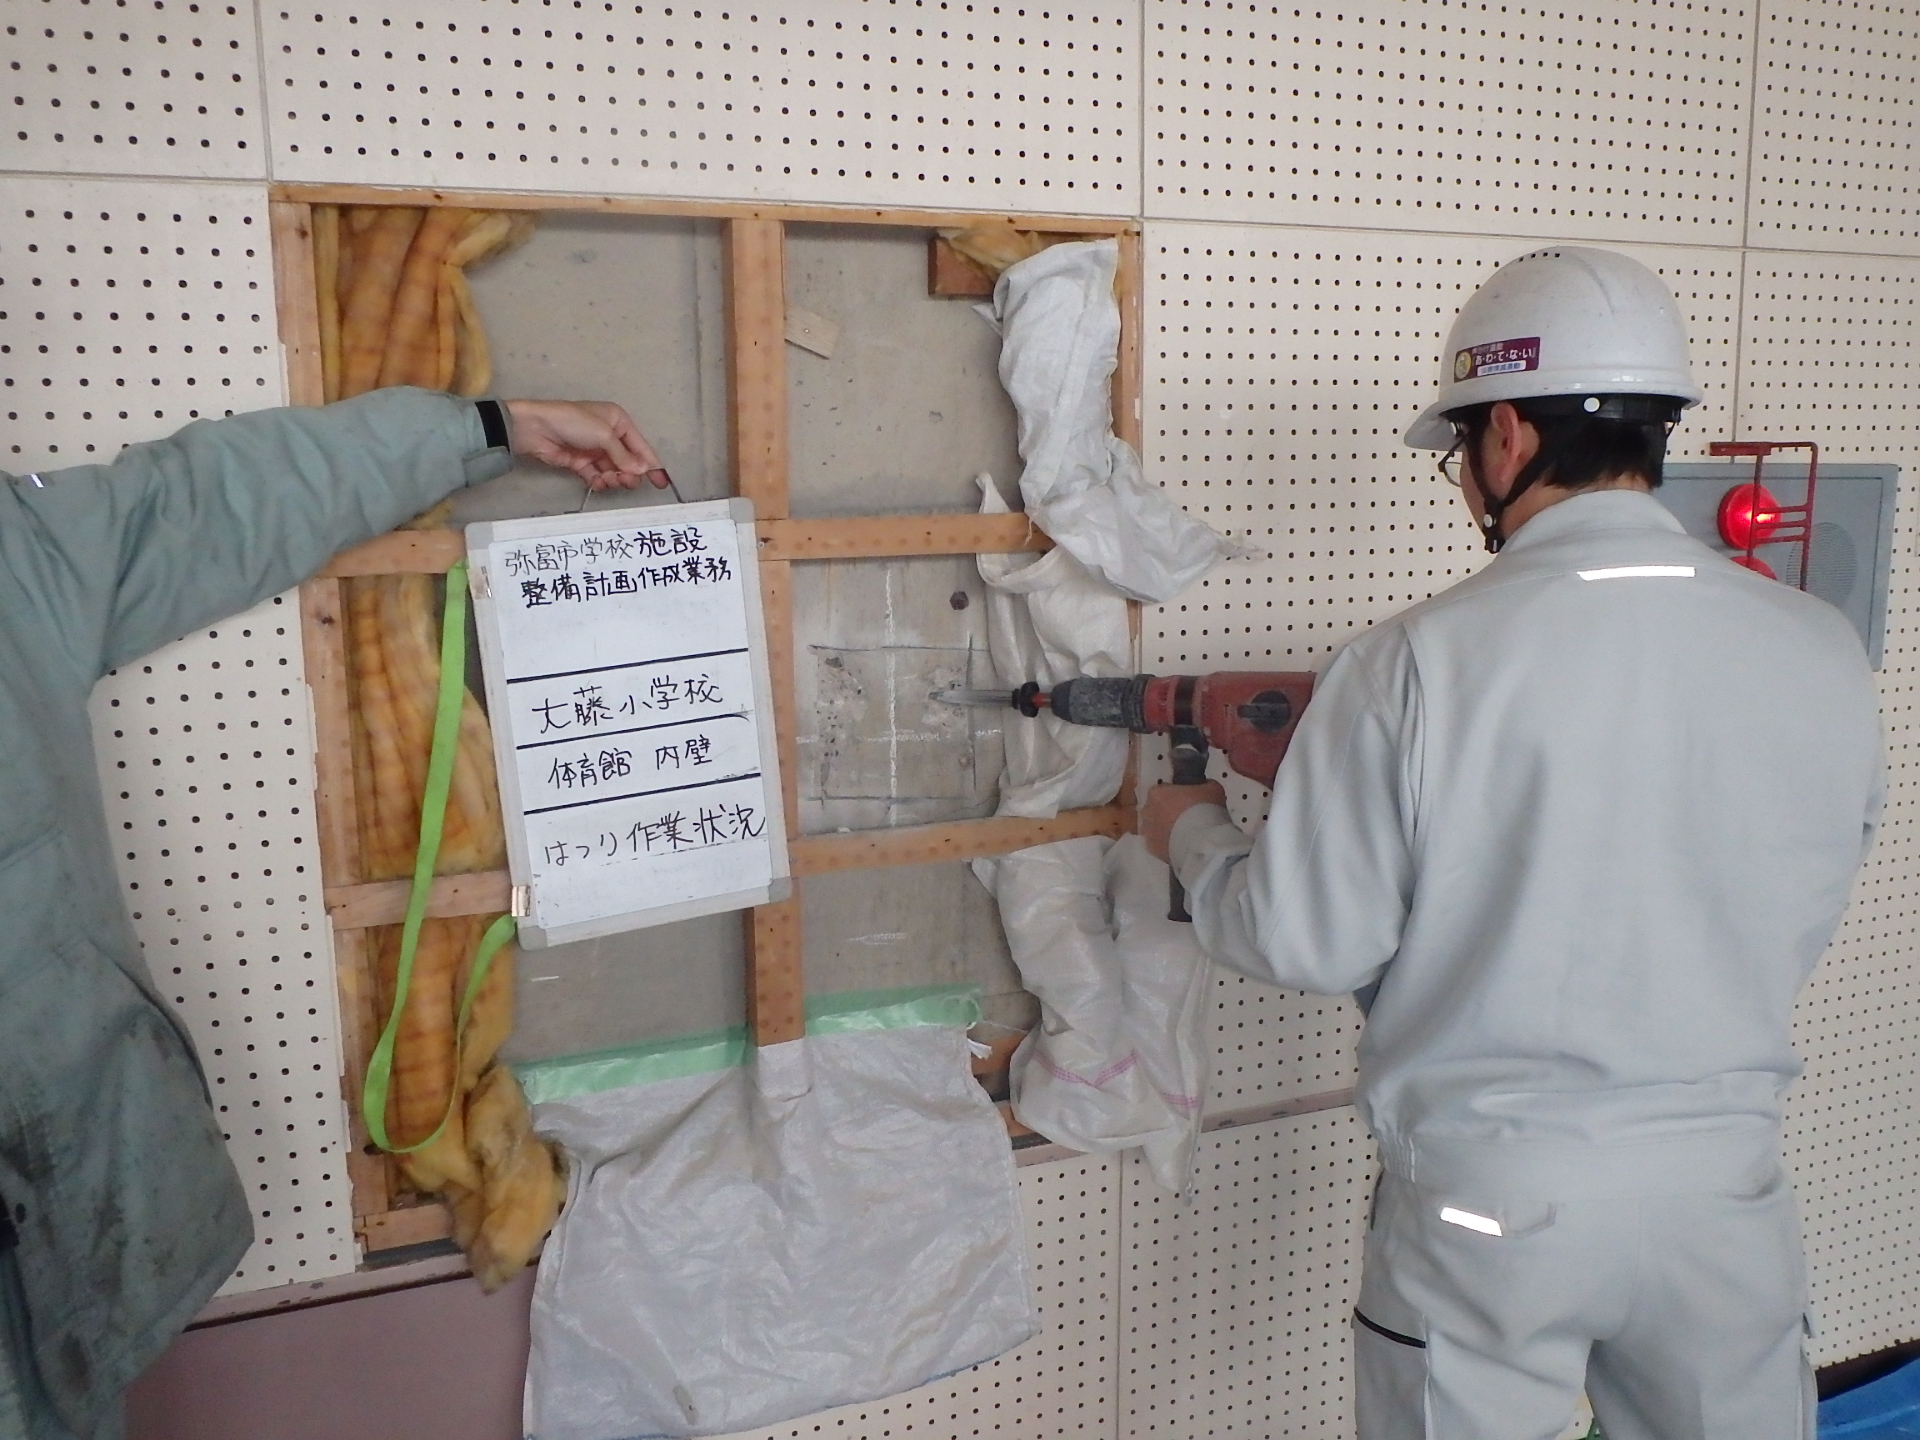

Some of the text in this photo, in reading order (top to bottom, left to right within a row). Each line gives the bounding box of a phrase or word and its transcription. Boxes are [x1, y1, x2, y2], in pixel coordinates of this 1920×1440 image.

[505, 527, 707, 577] 弥富市学校施設
[521, 556, 732, 609] 整備計画作成業務
[532, 674, 723, 734] 大藤小学校
[548, 734, 713, 789] 体育館 内壁
[545, 803, 766, 866] はつり作業状況
